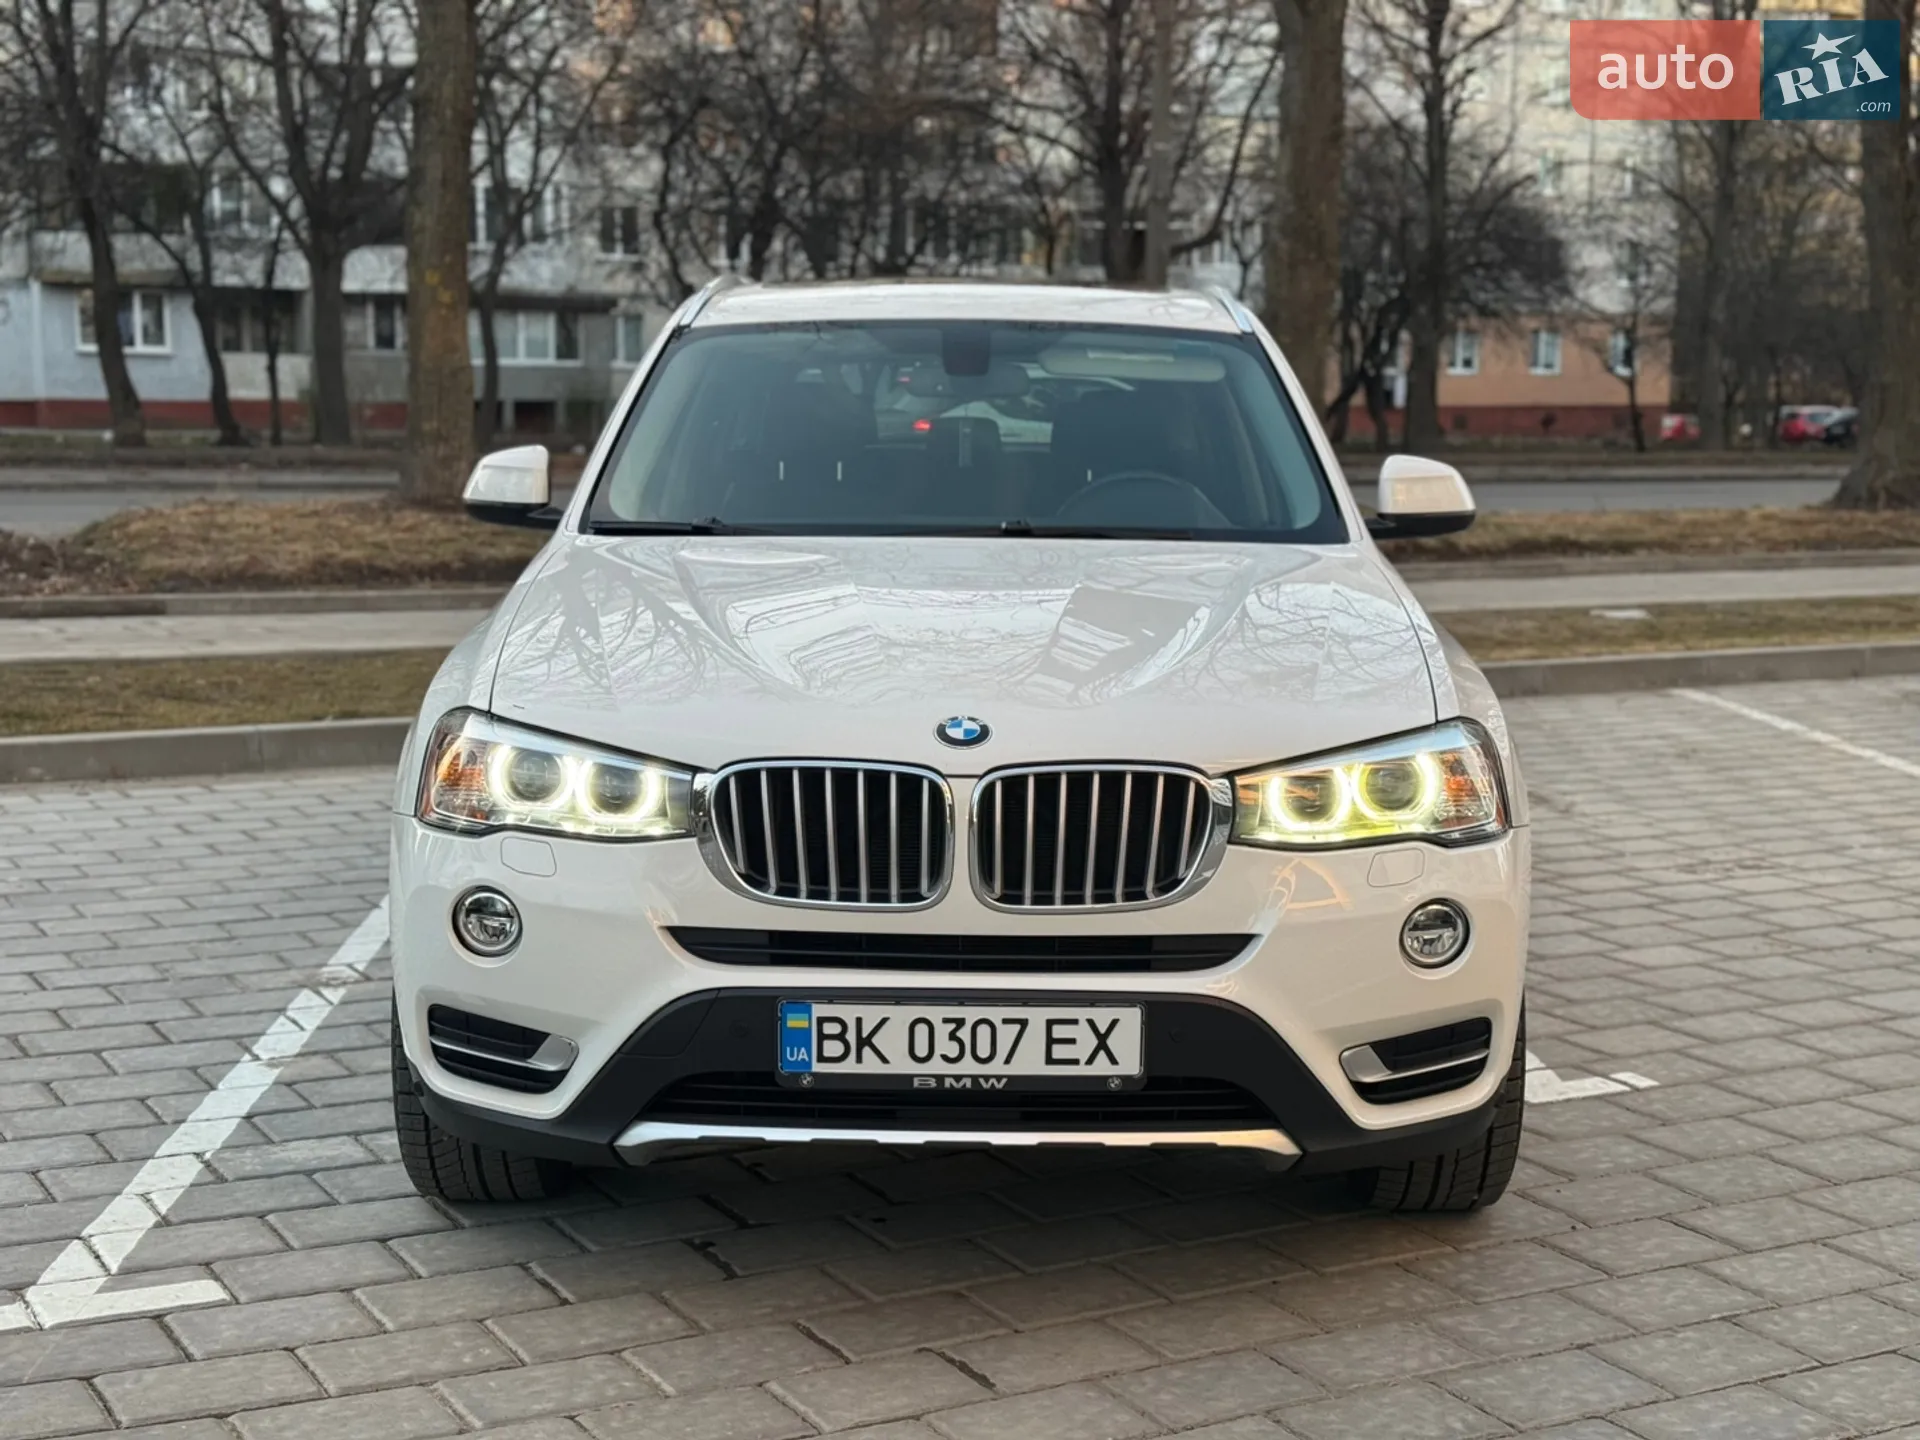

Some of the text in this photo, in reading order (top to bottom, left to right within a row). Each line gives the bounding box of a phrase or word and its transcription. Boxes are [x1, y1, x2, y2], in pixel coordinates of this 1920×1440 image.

[816, 1016, 1121, 1066] BK 0307 EX
[786, 1046, 809, 1062] UA
[912, 1077, 1009, 1089] BMW
